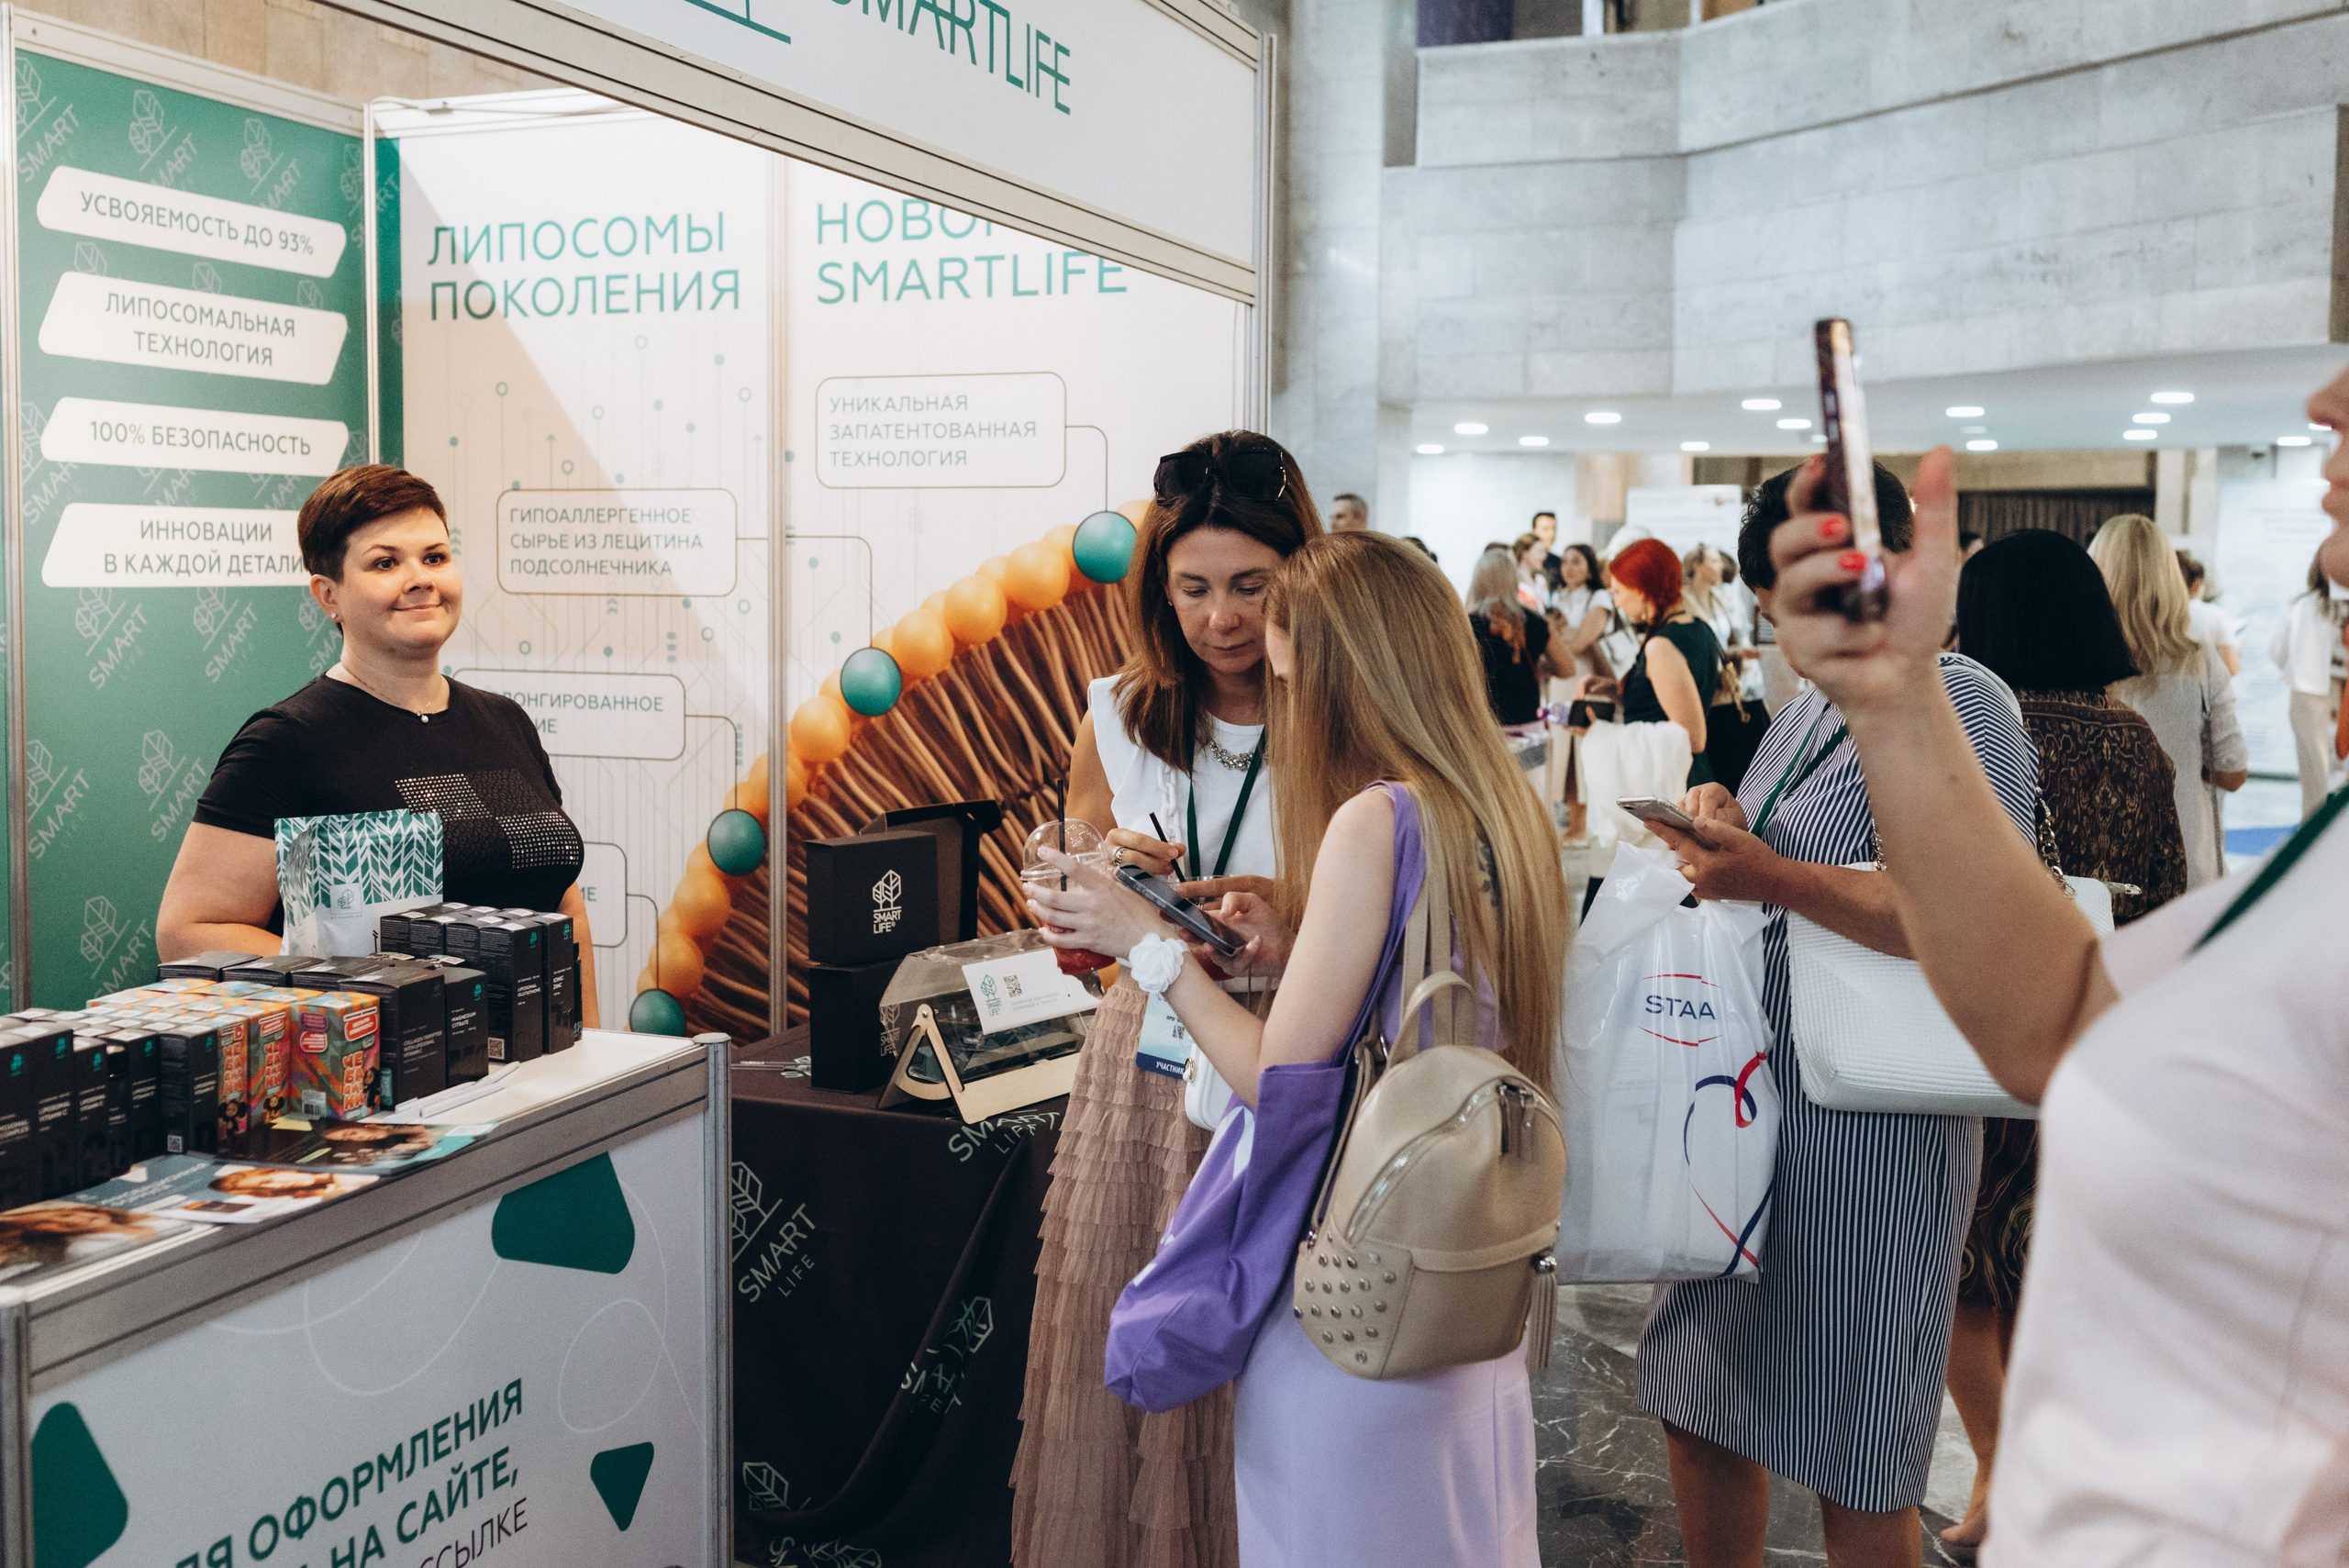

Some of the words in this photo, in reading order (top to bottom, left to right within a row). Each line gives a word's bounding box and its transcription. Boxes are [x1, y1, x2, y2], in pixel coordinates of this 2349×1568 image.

[830, 0, 1071, 116] ARTLIFE
[17, 103, 80, 183] SMART
[150, 132, 197, 188] MART
[261, 157, 302, 209] MART
[81, 190, 239, 241] УСВОЯЕМОСТЬ
[244, 224, 273, 249] ДО
[279, 230, 315, 256] 93%
[427, 211, 724, 266] ЛИПОСОМЫ
[431, 269, 740, 321] ПОКОЛЕНИЯ
[817, 250, 1129, 305] SMARTLIFE
[105, 292, 295, 339] ЛИПОСОМАЛЬНАЯ
[134, 330, 273, 366] ТЕХНОЛОГИЯ
[829, 395, 968, 413] УНИКАЛЬНАЯ
[90, 420, 146, 445] 100%
[151, 425, 312, 456] БЕЗОПАСНОСТЬ
[829, 421, 1037, 440] ЗАПАТЕНТОВАННАЯ
[829, 450, 968, 467] ТЕХНОЛОГИЯ
[140, 519, 273, 545] ИННОВАЦИИ
[510, 507, 692, 524] ГИПОАЛЛЕРГЕННОЕ
[104, 553, 117, 573] В
[125, 549, 222, 577] КАЖДОЙ
[227, 553, 304, 577] ДЕТАЛИ
[510, 533, 569, 550] СЫРЬЕ
[574, 533, 597, 549] ИЗ
[602, 533, 704, 551] ЛЕЦИТИНА
[510, 558, 673, 577] ПОДСОЛНЕЧНИКА
[89, 603, 148, 690] SMART
[206, 602, 258, 684] SMART
[503, 691, 663, 713] ОНГИРОВАННОЕ
[28, 768, 90, 860] SMART
[150, 757, 206, 842] SMART
[873, 909, 902, 923] SMART
[1156, 1061, 1185, 1075] УЧАСТНИК
[948, 1111, 1060, 1162] SMART
[737, 1203, 817, 1304] SMART
[778, 1253, 816, 1298] LIFE
[248, 1377, 524, 1562] ОФОРМЛЕНИЯ
[396, 1445, 519, 1545] САЙТЕ,
